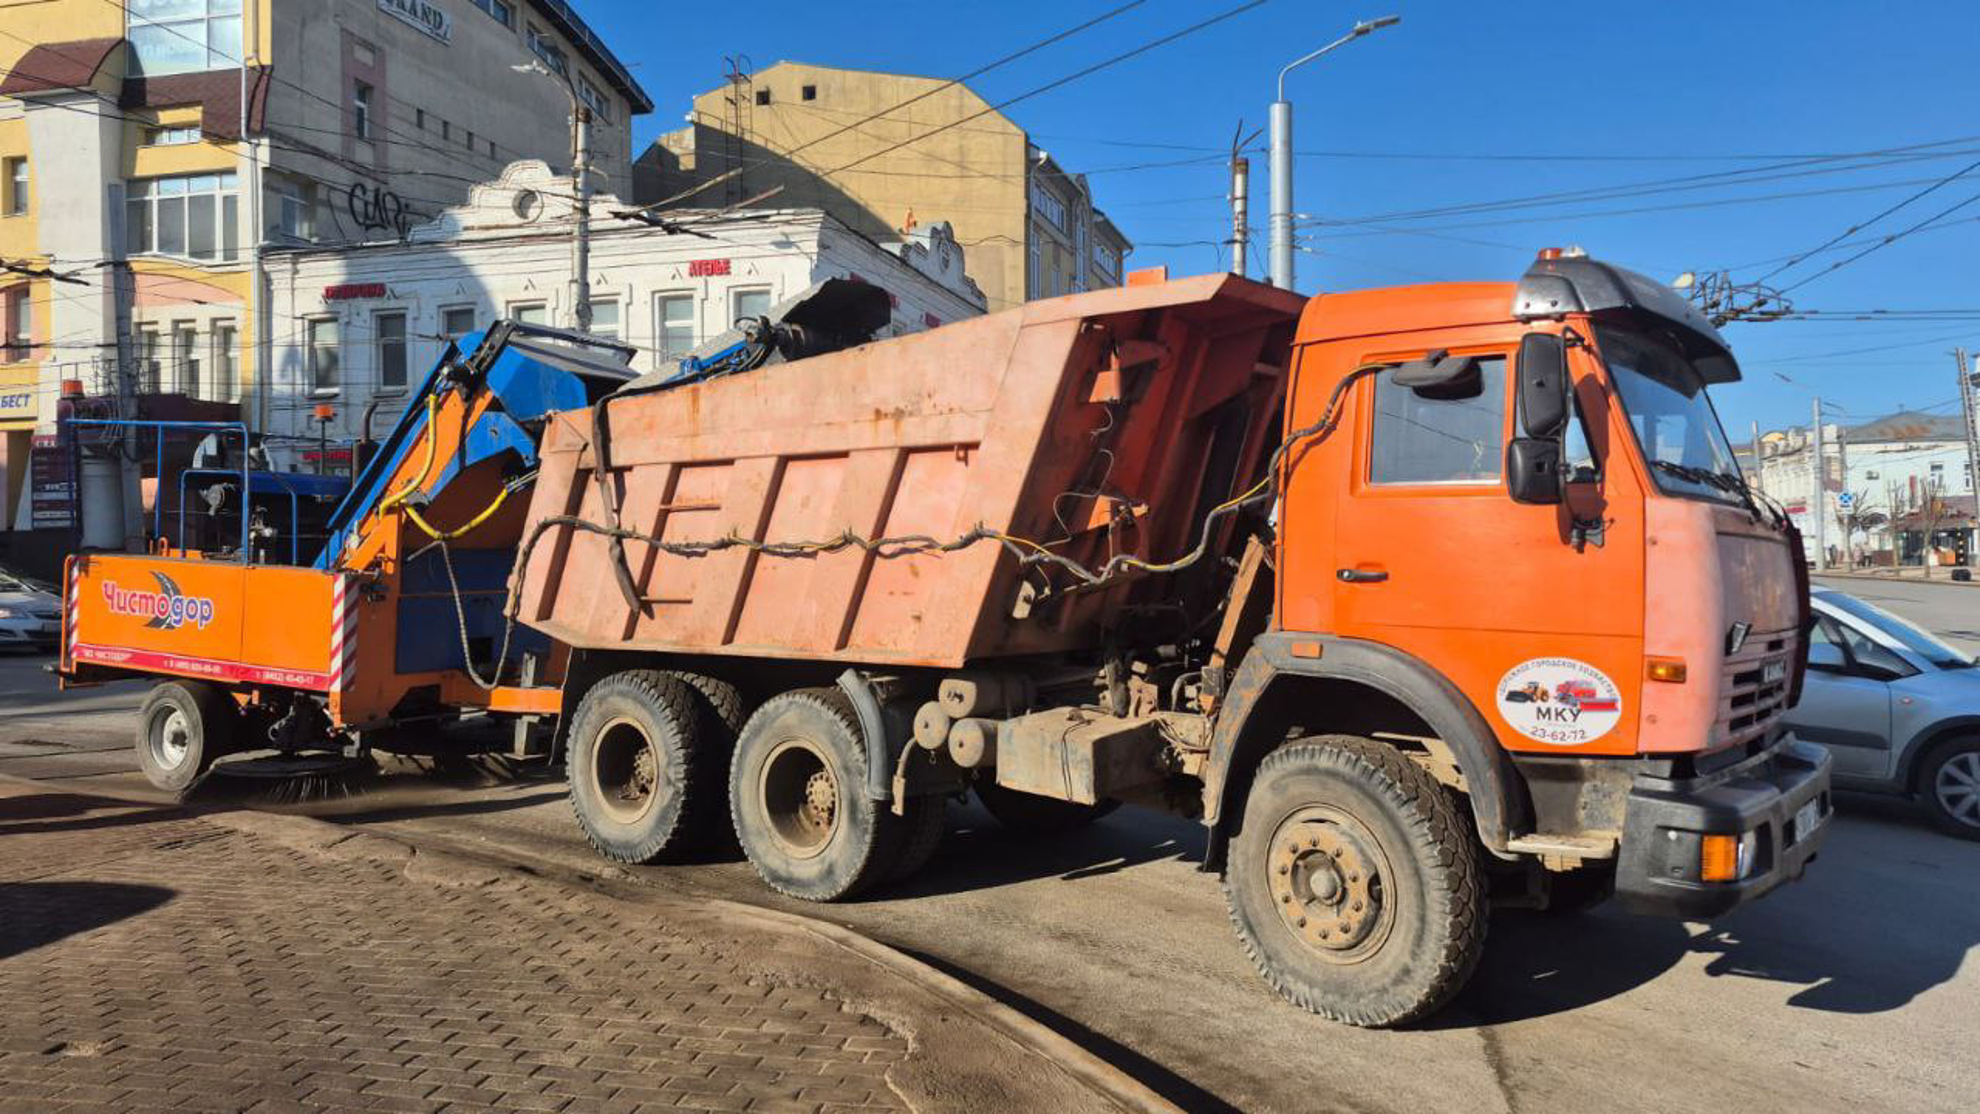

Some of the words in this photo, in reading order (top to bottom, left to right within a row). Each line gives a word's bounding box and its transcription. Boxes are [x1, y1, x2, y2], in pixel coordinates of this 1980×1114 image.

[103, 580, 214, 630] Чистодор
[1536, 706, 1582, 723] МКУ
[1531, 726, 1586, 742] 23-62-72
